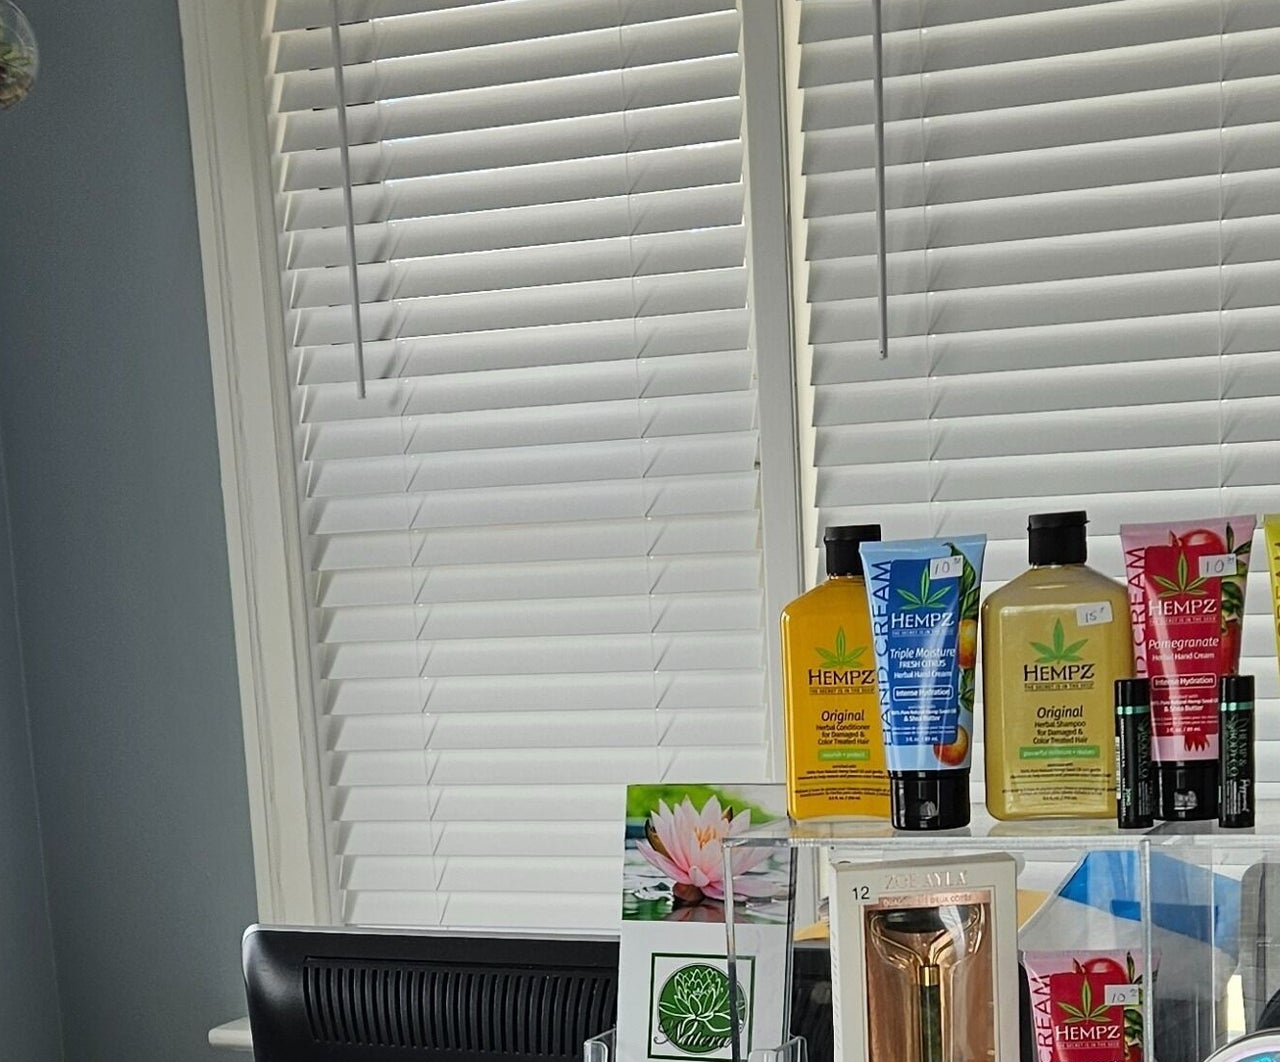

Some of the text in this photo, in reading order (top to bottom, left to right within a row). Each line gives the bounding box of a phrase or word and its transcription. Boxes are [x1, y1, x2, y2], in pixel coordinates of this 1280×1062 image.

[1125, 548, 1146, 646] CREAM
[1148, 599, 1217, 616] HEMPZ
[891, 612, 954, 628] HEMPZ
[1148, 637, 1220, 651] Pomegranate
[871, 560, 893, 746] HAND CREAM
[890, 647, 956, 660] Triple Moisture
[1152, 653, 1174, 661] Hel
[1174, 652, 1192, 660] Hand
[808, 668, 876, 686] HEMPZ
[1024, 663, 1096, 682] HEMPZ
[1180, 676, 1214, 686] Hydration
[821, 709, 865, 724] Original
[1037, 705, 1083, 720] Original
[1056, 720, 1086, 728] Shampoo
[832, 731, 859, 739] Damaged
[1037, 728, 1046, 736] for
[1048, 728, 1077, 737] Damaged
[852, 886, 870, 900] 12
[1055, 1025, 1121, 1041] HEMPZ
